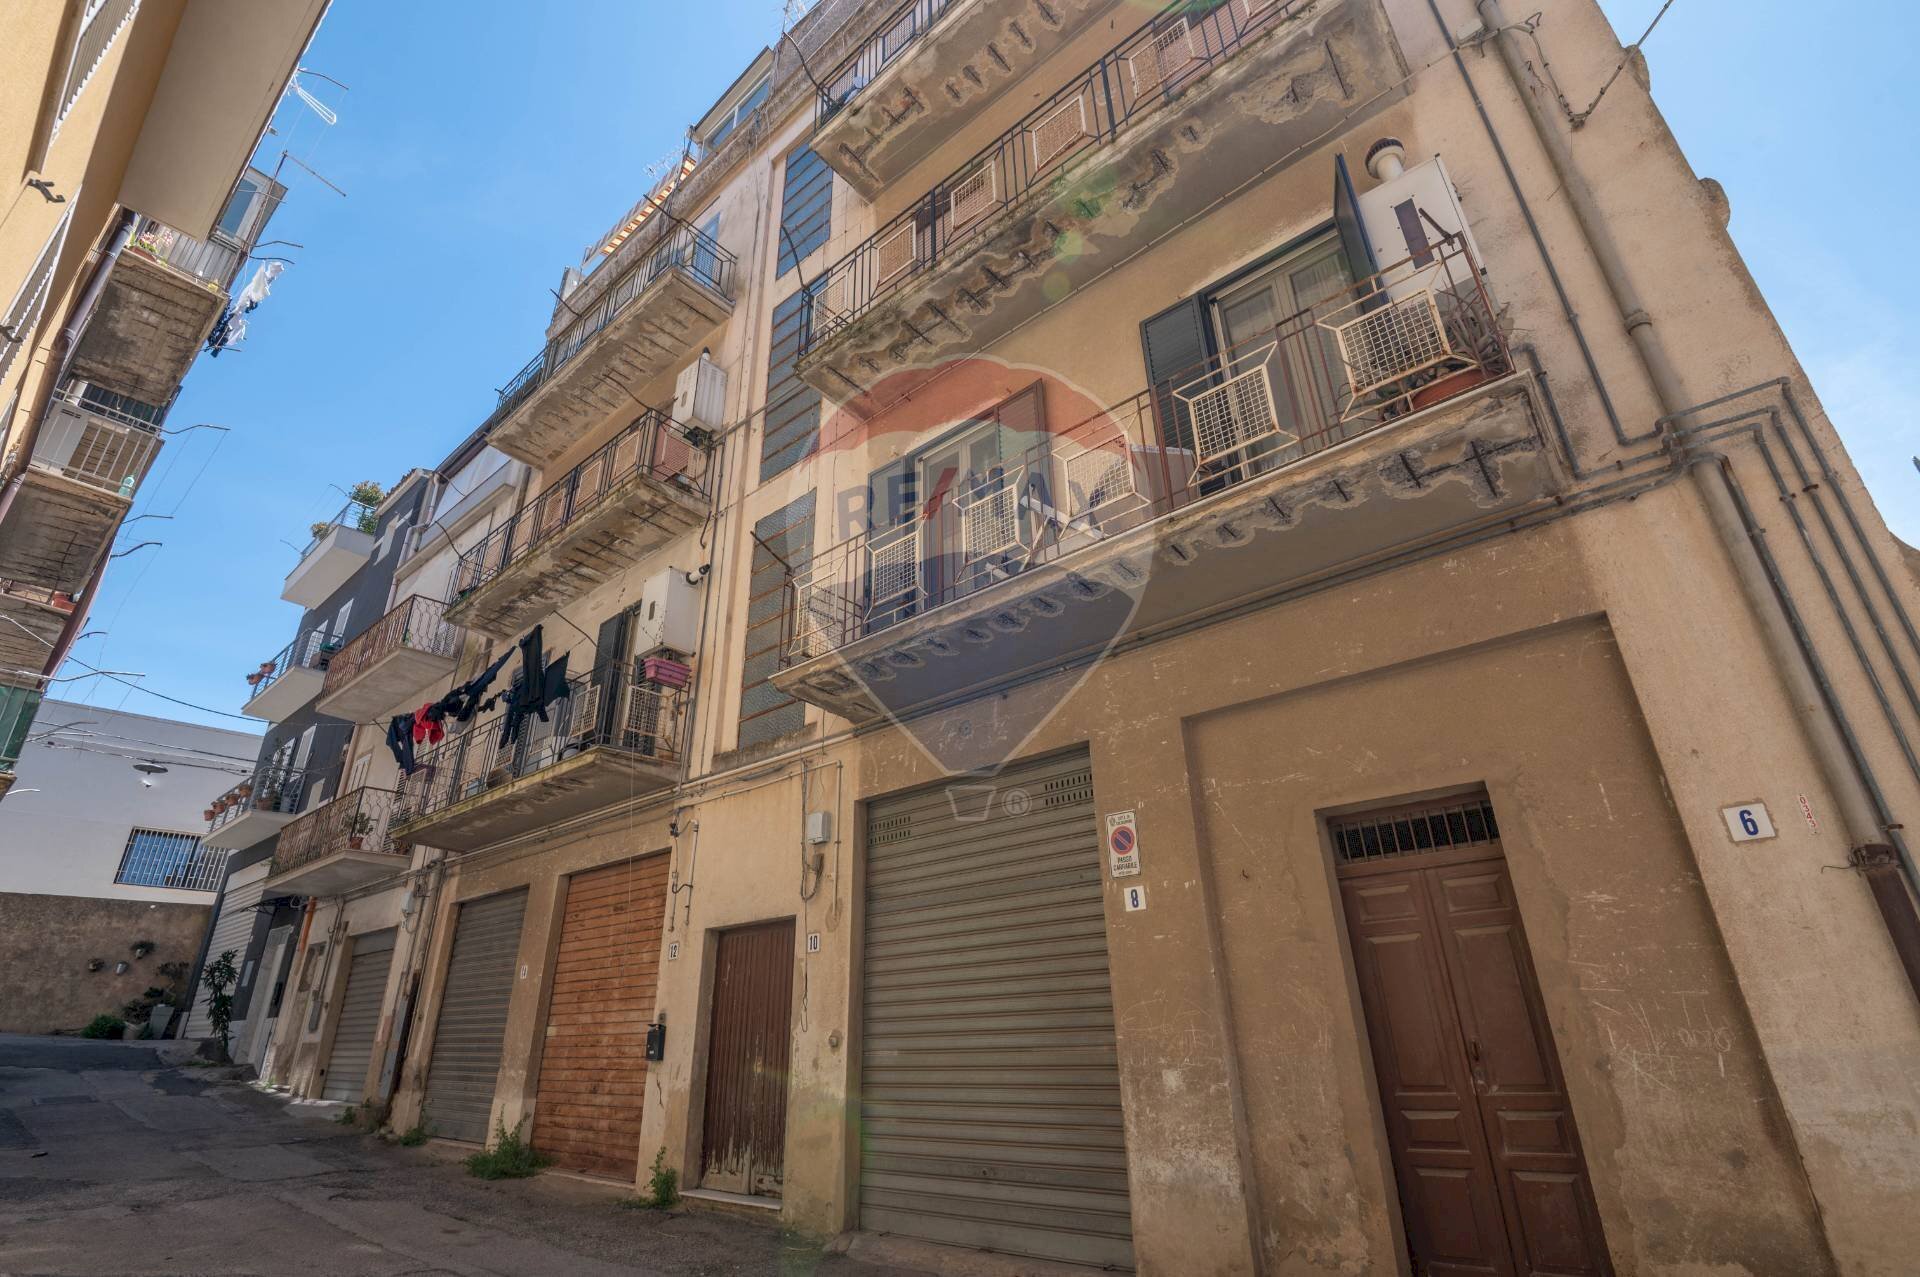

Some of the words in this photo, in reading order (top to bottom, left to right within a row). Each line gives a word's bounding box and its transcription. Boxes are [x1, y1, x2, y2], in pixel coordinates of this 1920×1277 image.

[1738, 809, 1759, 836] 6
[1117, 855, 1133, 864] PASSO
[1130, 888, 1140, 908] 8
[809, 935, 818, 950] 10
[670, 945, 678, 958] 12
